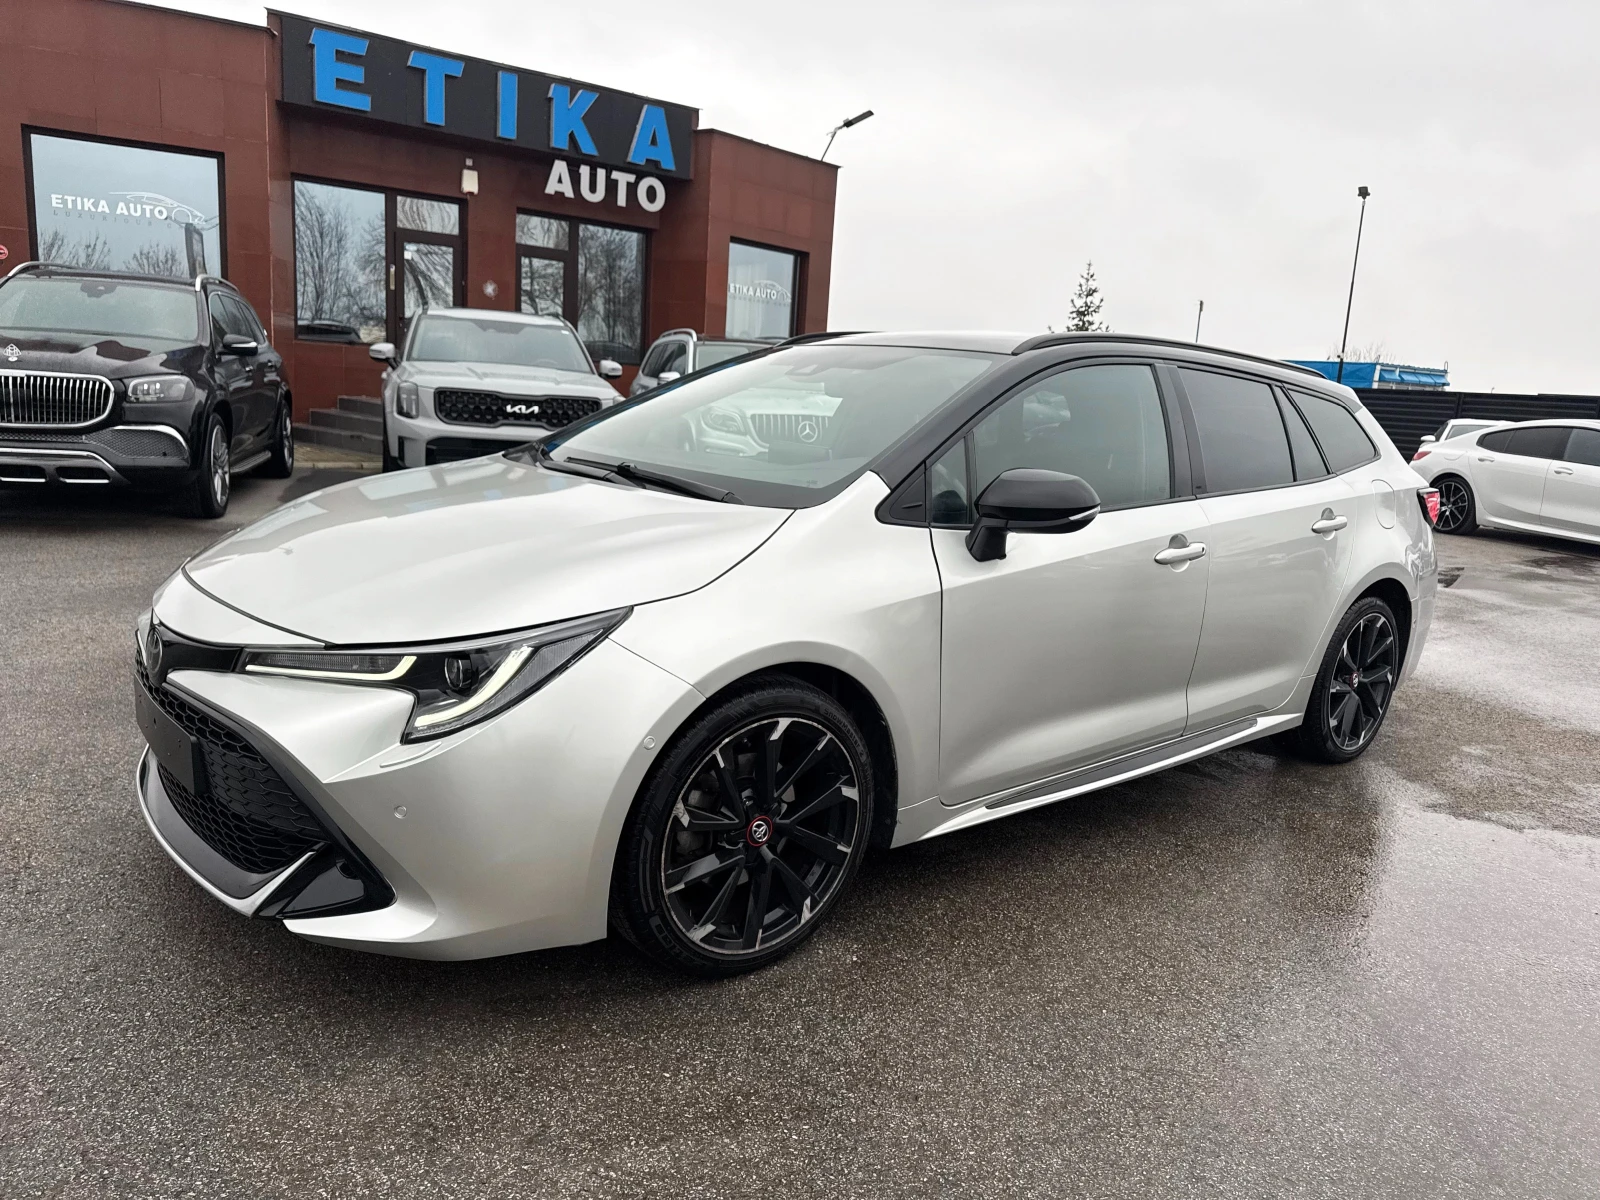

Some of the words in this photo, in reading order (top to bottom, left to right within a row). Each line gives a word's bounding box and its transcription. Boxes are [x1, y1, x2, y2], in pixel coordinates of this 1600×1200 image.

[309, 27, 676, 171] ETIKA
[544, 159, 666, 213] AUTO
[51, 194, 110, 214] ETIKA
[116, 201, 168, 220] AUTO
[729, 283, 754, 296] ETIKA
[755, 287, 777, 300] AUTO
